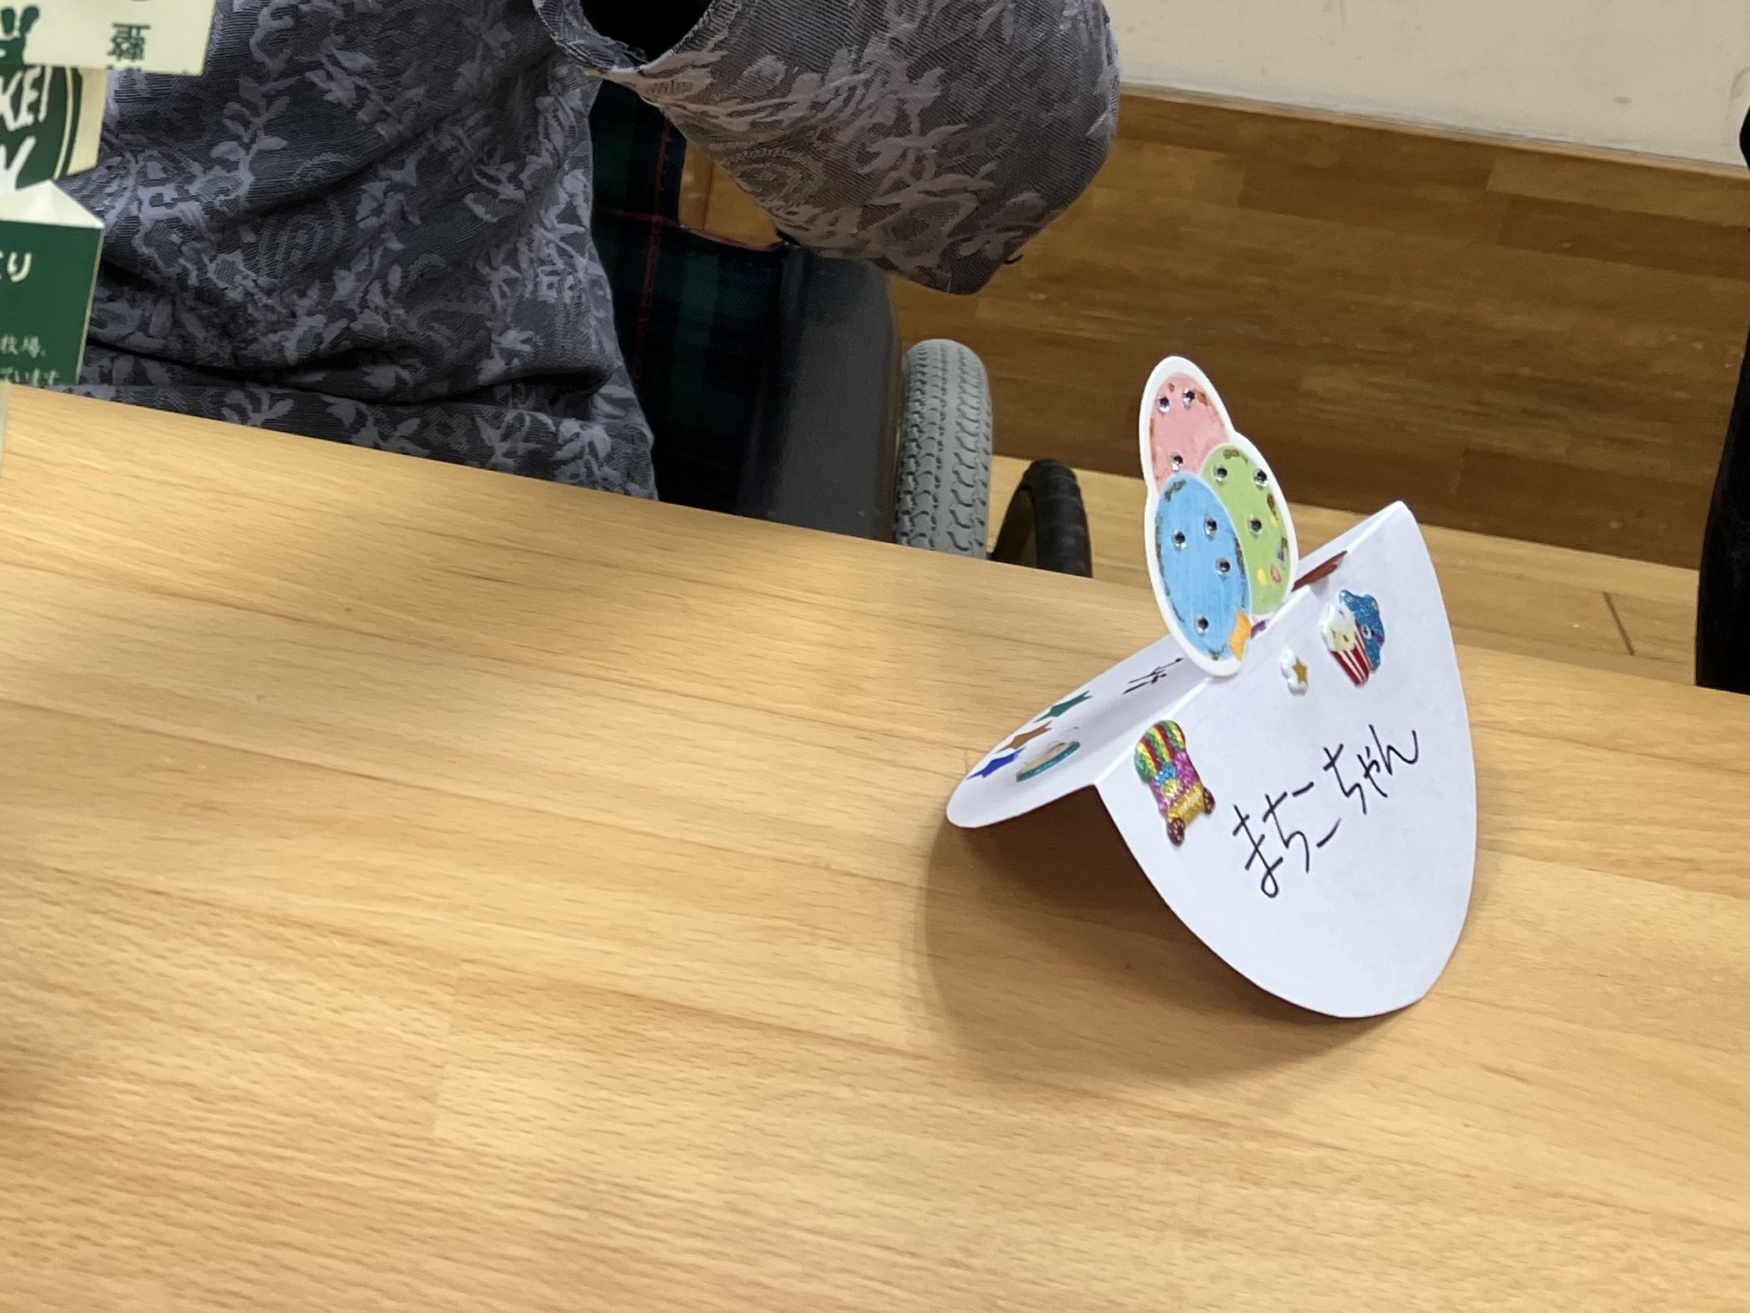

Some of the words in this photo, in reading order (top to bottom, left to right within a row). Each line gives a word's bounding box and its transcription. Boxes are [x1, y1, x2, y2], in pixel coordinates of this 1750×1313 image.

[107, 23, 151, 68] 整
[1233, 724, 1419, 898] まちこちゃん
